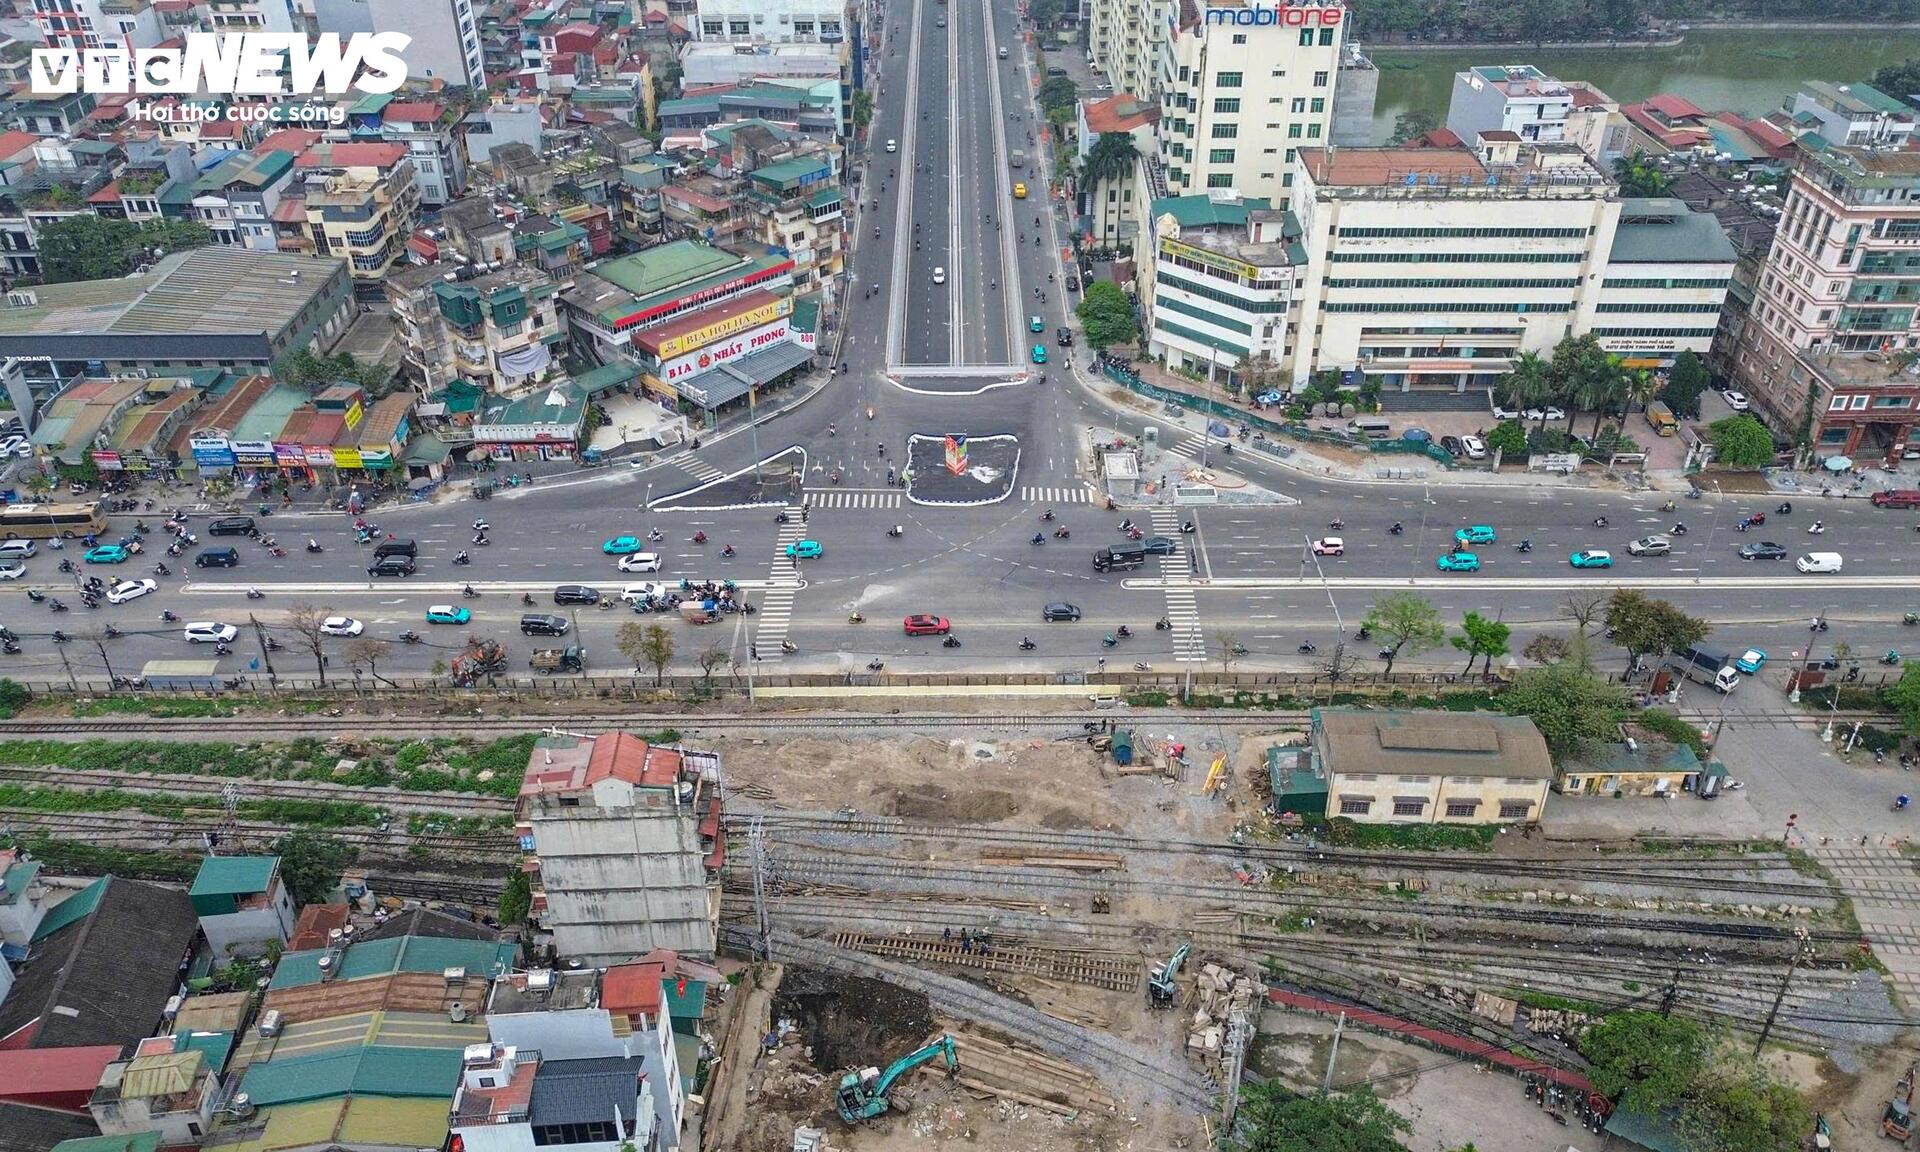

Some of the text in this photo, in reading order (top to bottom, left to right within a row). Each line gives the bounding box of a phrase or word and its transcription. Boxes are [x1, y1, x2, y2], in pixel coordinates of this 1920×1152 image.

[1206, 3, 1341, 28] mobifone
[686, 331, 706, 345] BIA
[669, 363, 692, 379] BIA
[713, 341, 743, 361] NHẤT
[750, 328, 785, 347] PHONG
